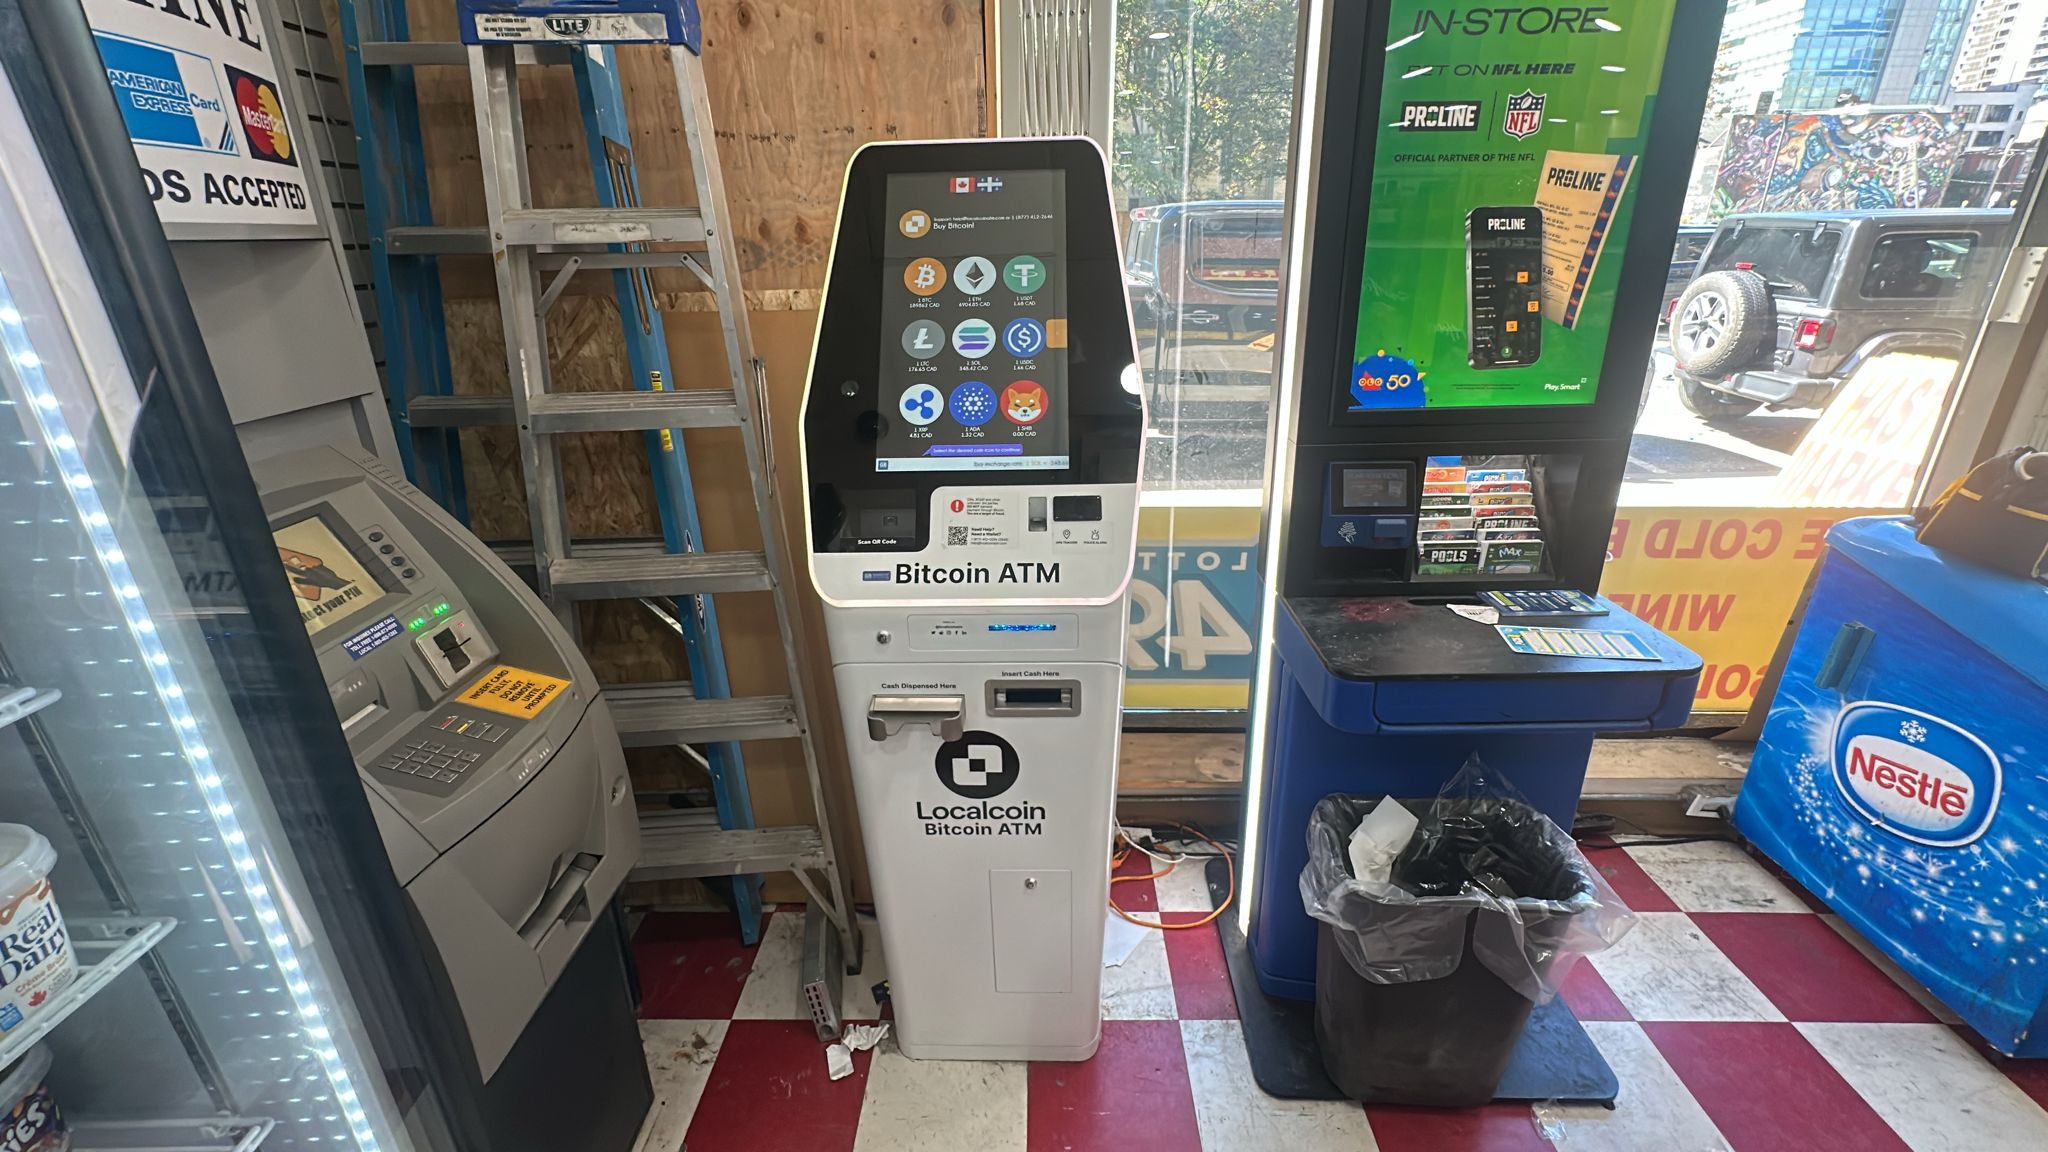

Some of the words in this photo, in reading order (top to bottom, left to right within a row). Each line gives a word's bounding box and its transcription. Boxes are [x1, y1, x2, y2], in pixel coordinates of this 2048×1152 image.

[553, 18, 584, 31] LITE
[1413, 7, 1609, 36] IN-STORE
[1454, 64, 1490, 76] ON
[1492, 63, 1522, 75] NFL
[1525, 62, 1576, 75] HERE
[108, 69, 185, 97] AMERICAN
[131, 92, 193, 117] EXPRESS
[189, 92, 221, 112] Card
[1404, 105, 1477, 127] PROLINE
[1507, 109, 1538, 131] NFL
[1394, 154, 1436, 162] OFFICIAL
[1438, 154, 1480, 162] PARTNER
[1482, 154, 1496, 162] OF
[1498, 153, 1516, 162] THE
[1518, 153, 1536, 161] NFL
[1547, 167, 1606, 192] PROLINE
[204, 172, 307, 210] ACCEPTED
[1488, 218, 1526, 231] PROLINE
[1386, 374, 1411, 390] 50
[1431, 550, 1468, 563] POOLS
[895, 562, 990, 584] Bitcoin
[998, 562, 1061, 584] ATM
[322, 595, 347, 612] your
[343, 585, 363, 600] PIN
[469, 682, 493, 699] INSERT
[490, 669, 509, 683] CARD
[489, 679, 512, 694] FULLY,
[499, 690, 510, 699] DO
[508, 680, 524, 693] NOT
[508, 681, 536, 702] REMOVE
[521, 687, 542, 701] UNTIL
[524, 684, 557, 710] PROMPTED
[916, 801, 1046, 820] Localcoin
[925, 822, 992, 836] Bitcoin
[998, 823, 1042, 836] ATM
[0, 902, 57, 961] Real
[0, 927, 65, 990] Dairy
